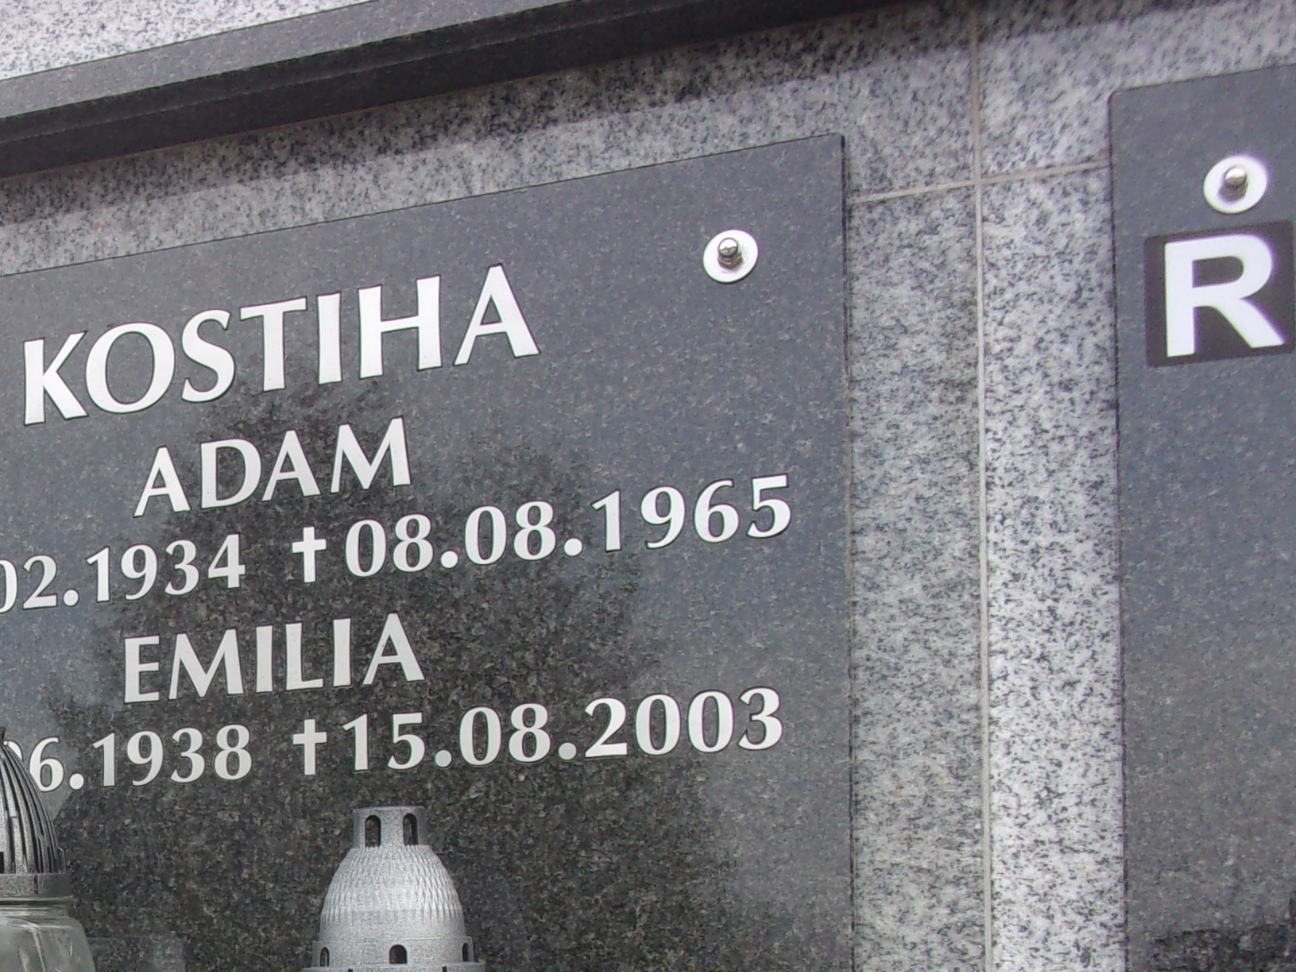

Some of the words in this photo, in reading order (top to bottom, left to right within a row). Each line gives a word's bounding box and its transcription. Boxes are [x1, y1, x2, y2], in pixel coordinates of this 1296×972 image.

[23, 265, 540, 426] KOSTIHA
[1165, 234, 1284, 357] R
[133, 416, 413, 518] ADAM
[344, 474, 792, 578] 08.08.1965
[123, 613, 425, 704] EMILIA
[341, 686, 784, 771] 15.08.2003
